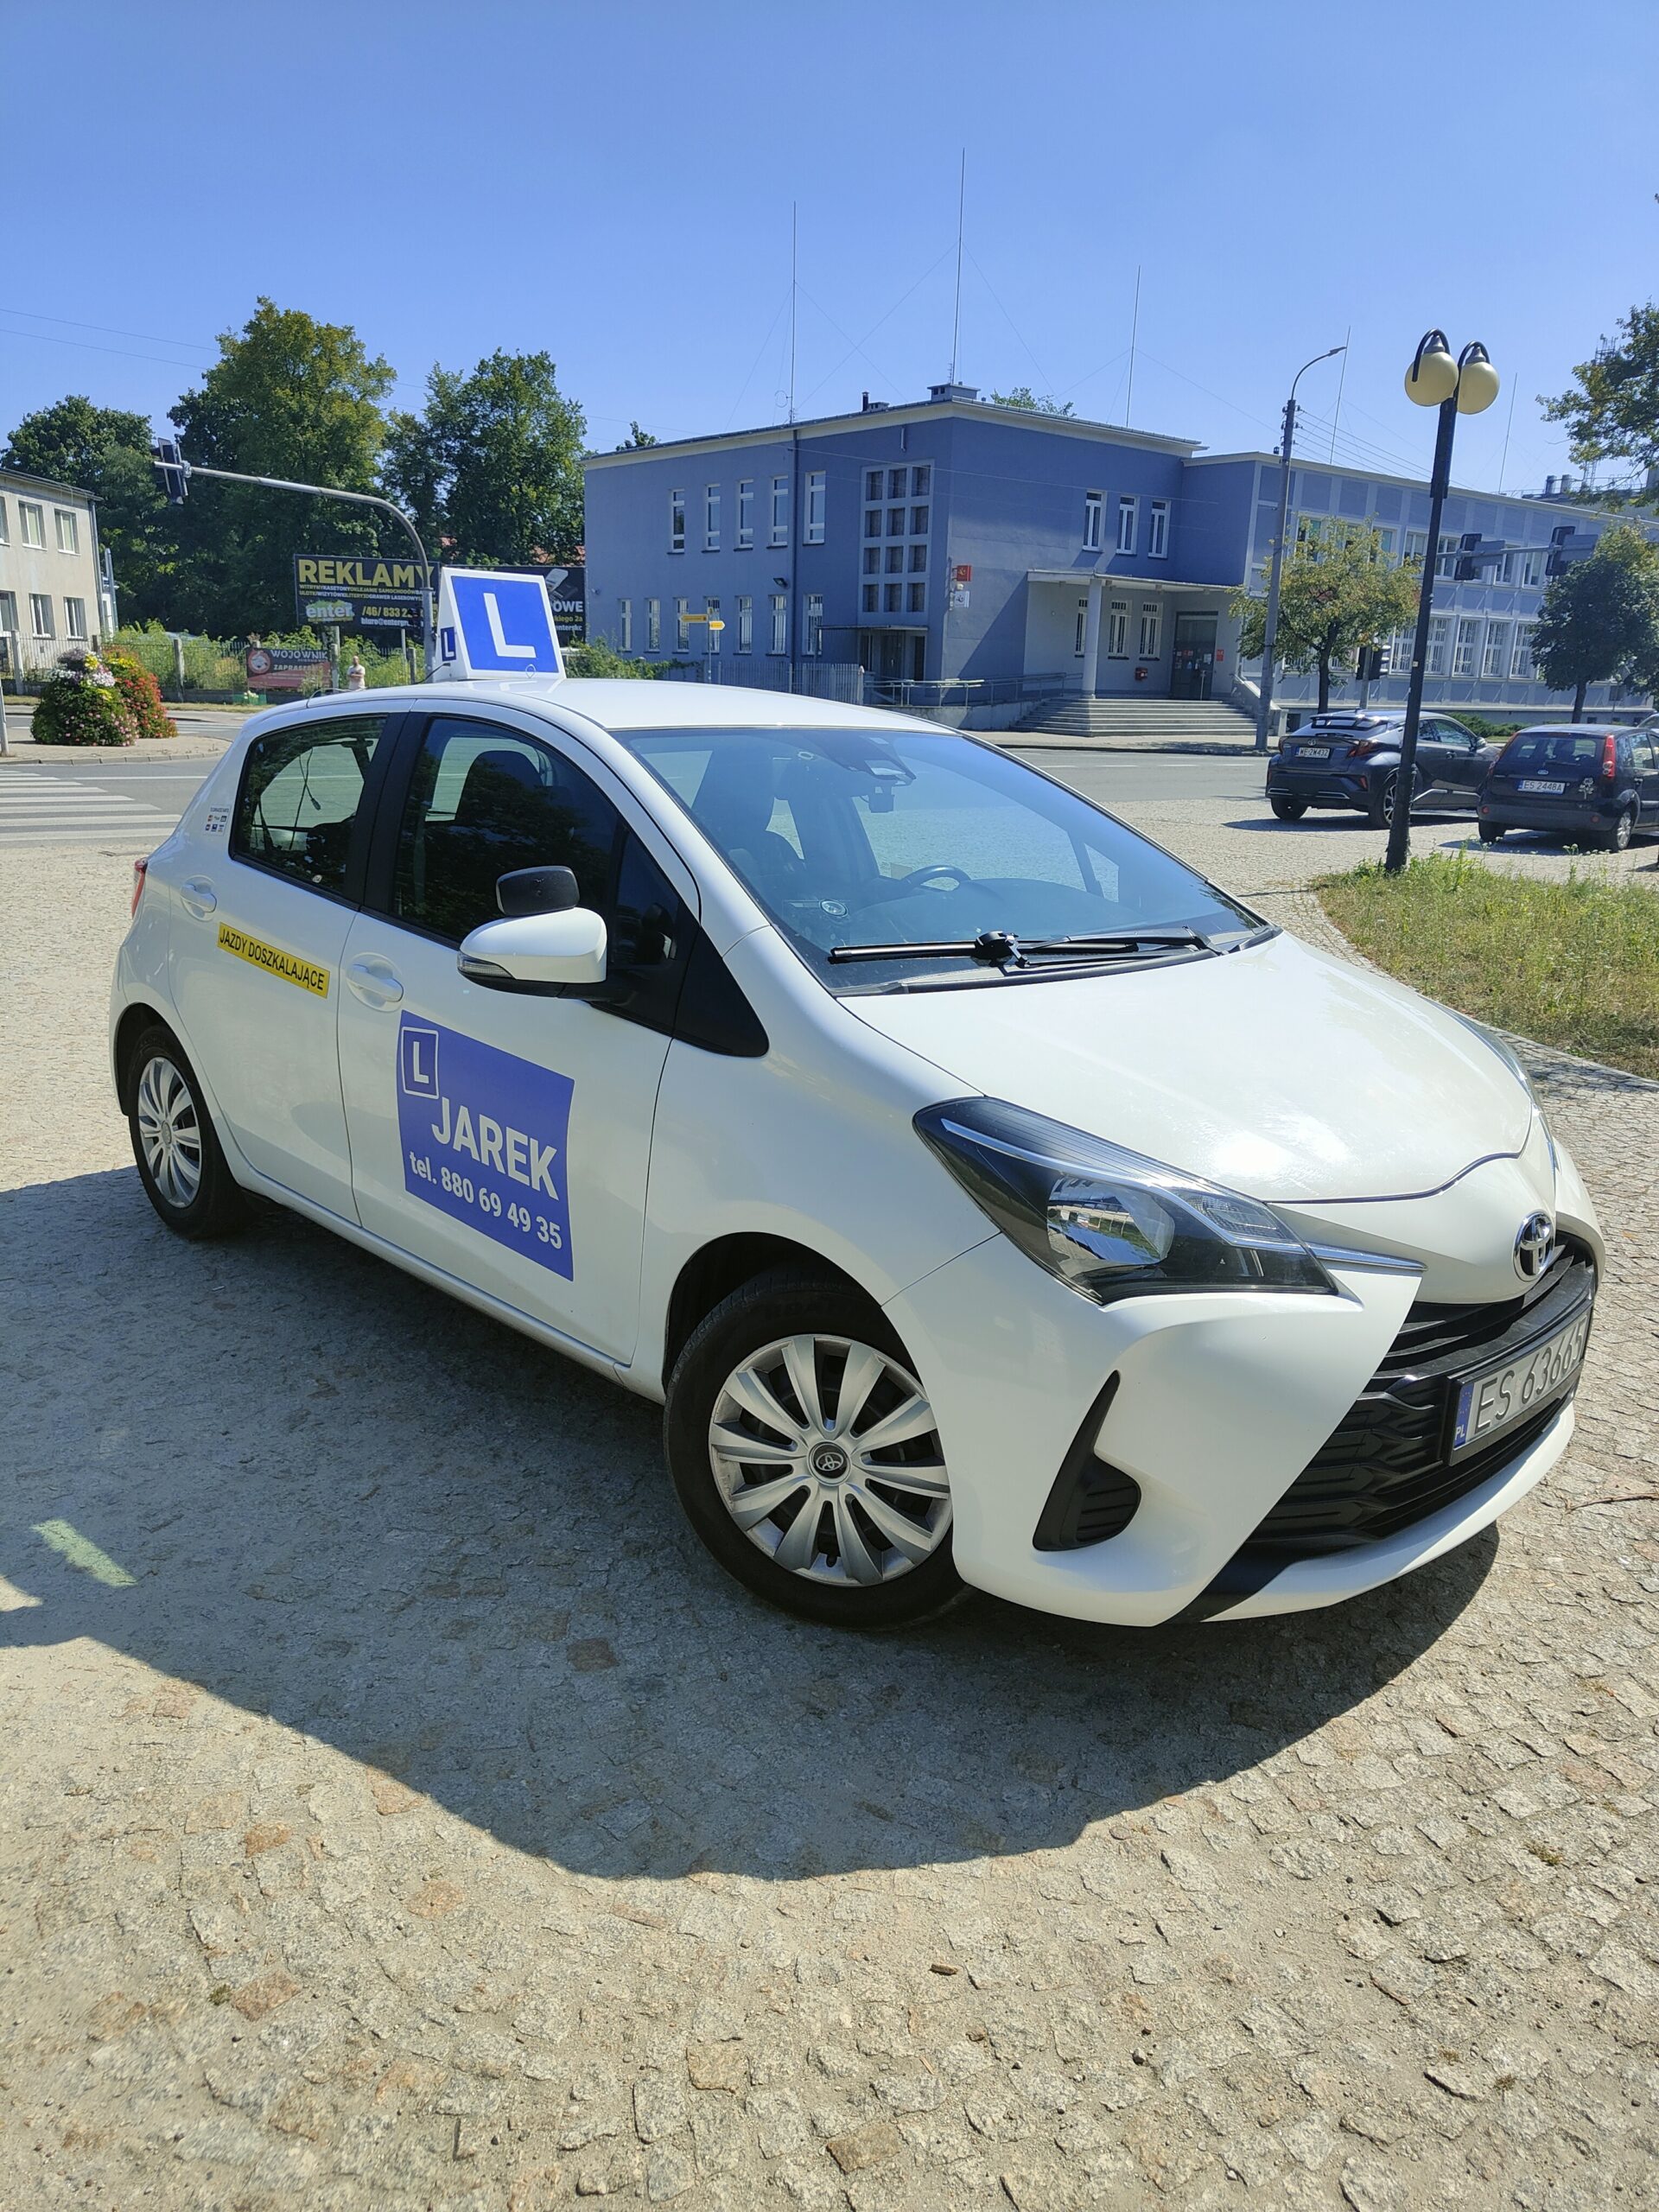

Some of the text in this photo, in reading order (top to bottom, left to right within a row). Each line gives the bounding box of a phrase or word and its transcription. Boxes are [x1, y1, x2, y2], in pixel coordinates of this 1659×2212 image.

[298, 559, 435, 588] REKLAMY
[483, 593, 537, 658] L
[550, 601, 584, 613] OWE
[270, 649, 328, 659] WOJOWNIK
[443, 631, 454, 658] L
[1523, 780, 1535, 790] ES
[219, 928, 325, 990] JAZDY DOSZKALAJĄCE
[413, 1040, 429, 1084] L
[431, 1096, 559, 1201] JAREK
[410, 1150, 563, 1249] tel. 880 69 49 35
[1454, 1314, 1587, 1441] PL ES 63665
